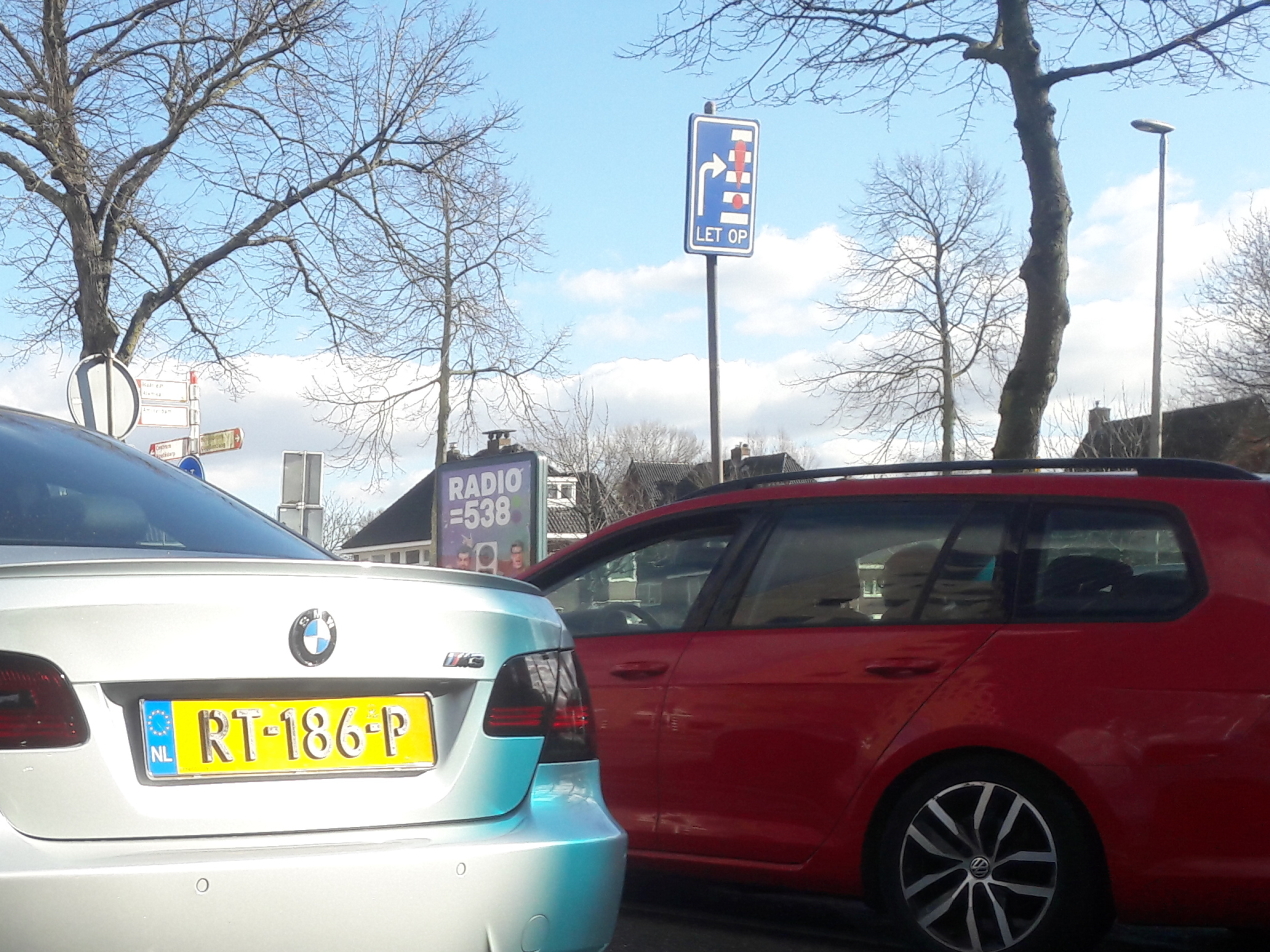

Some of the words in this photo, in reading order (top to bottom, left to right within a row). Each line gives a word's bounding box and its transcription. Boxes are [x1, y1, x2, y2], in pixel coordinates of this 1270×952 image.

[696, 225, 723, 242] LET
[728, 228, 748, 244] OP
[449, 467, 523, 500] RADIO
[198, 705, 408, 764] RT-186-P
[151, 745, 173, 763] NL
